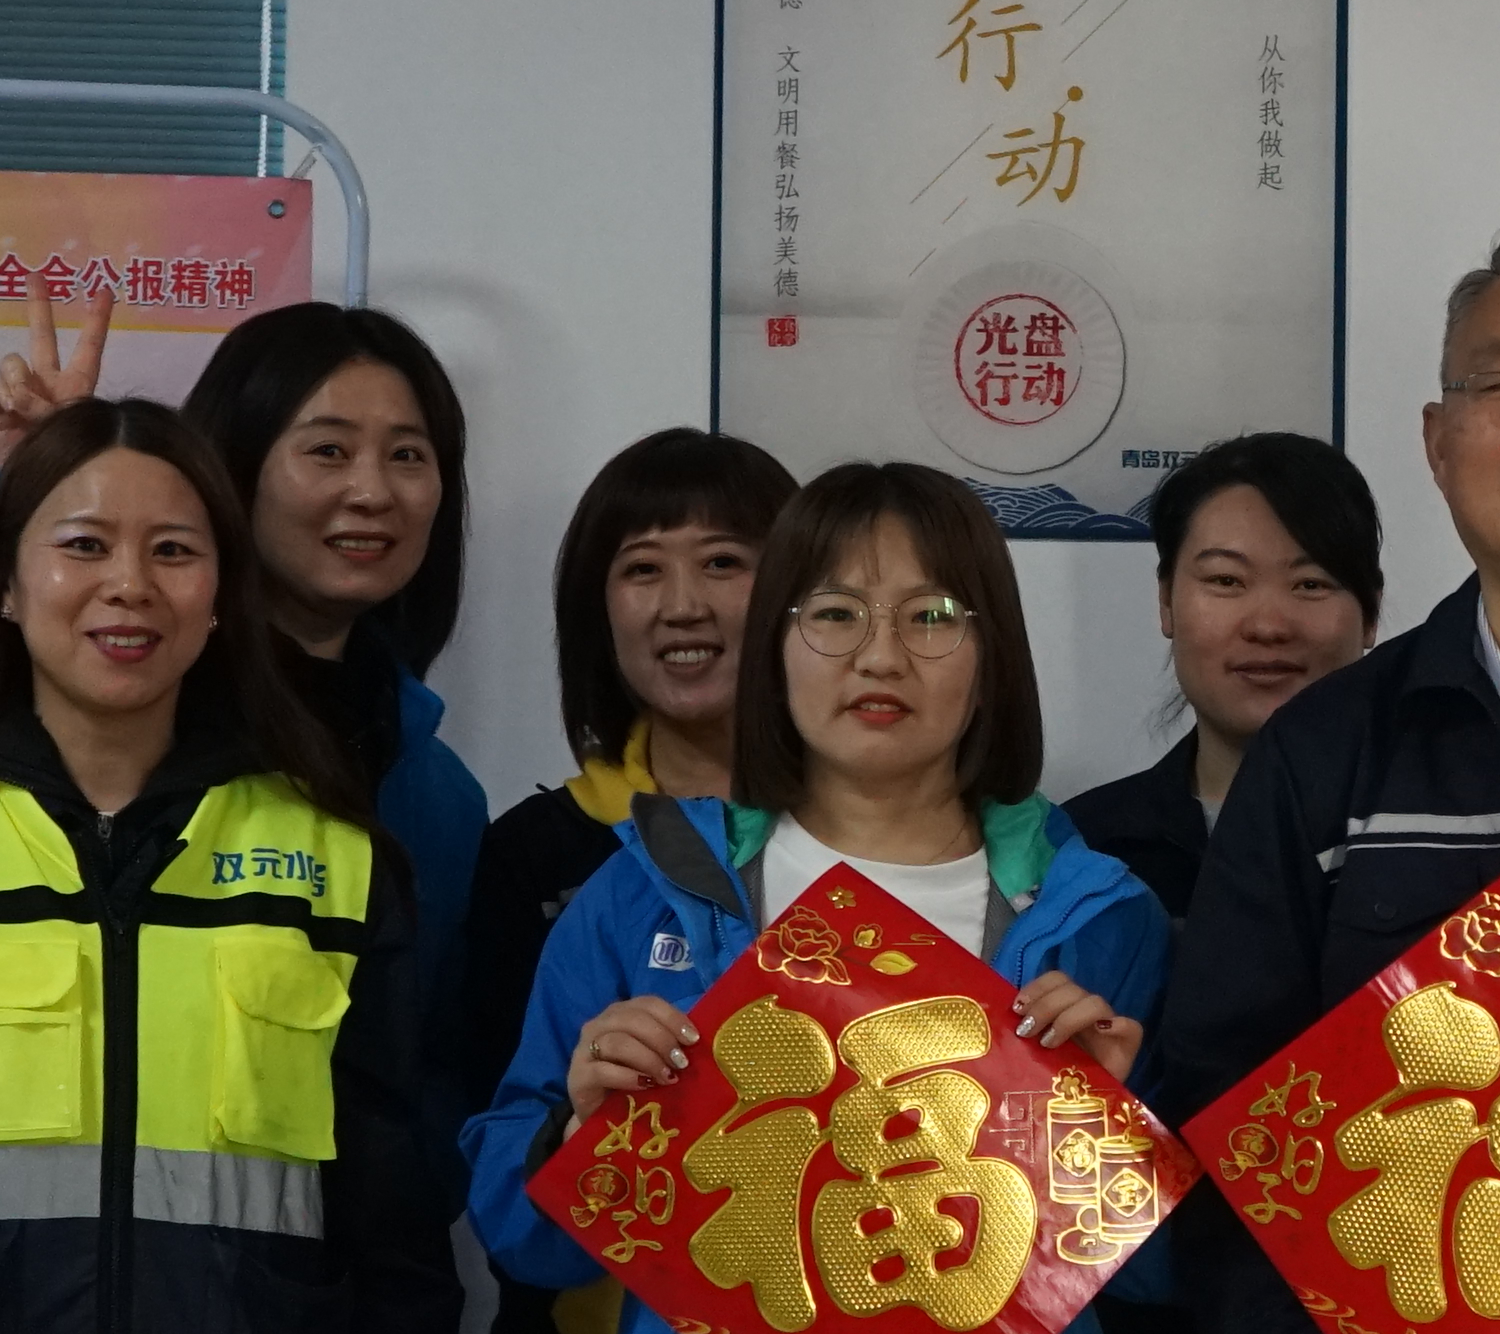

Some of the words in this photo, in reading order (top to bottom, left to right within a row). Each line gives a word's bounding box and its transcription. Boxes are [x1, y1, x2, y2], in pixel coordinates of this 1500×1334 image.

[773, 46, 801, 298] 文明用餐弘扬美德
[1257, 34, 1286, 191] 从你我做起
[975, 311, 1067, 357] 光盘
[975, 362, 1066, 407] 行动
[594, 1095, 681, 1263] 好日子
[682, 994, 1037, 1332] 福
[1243, 1060, 1338, 1224] 好日子
